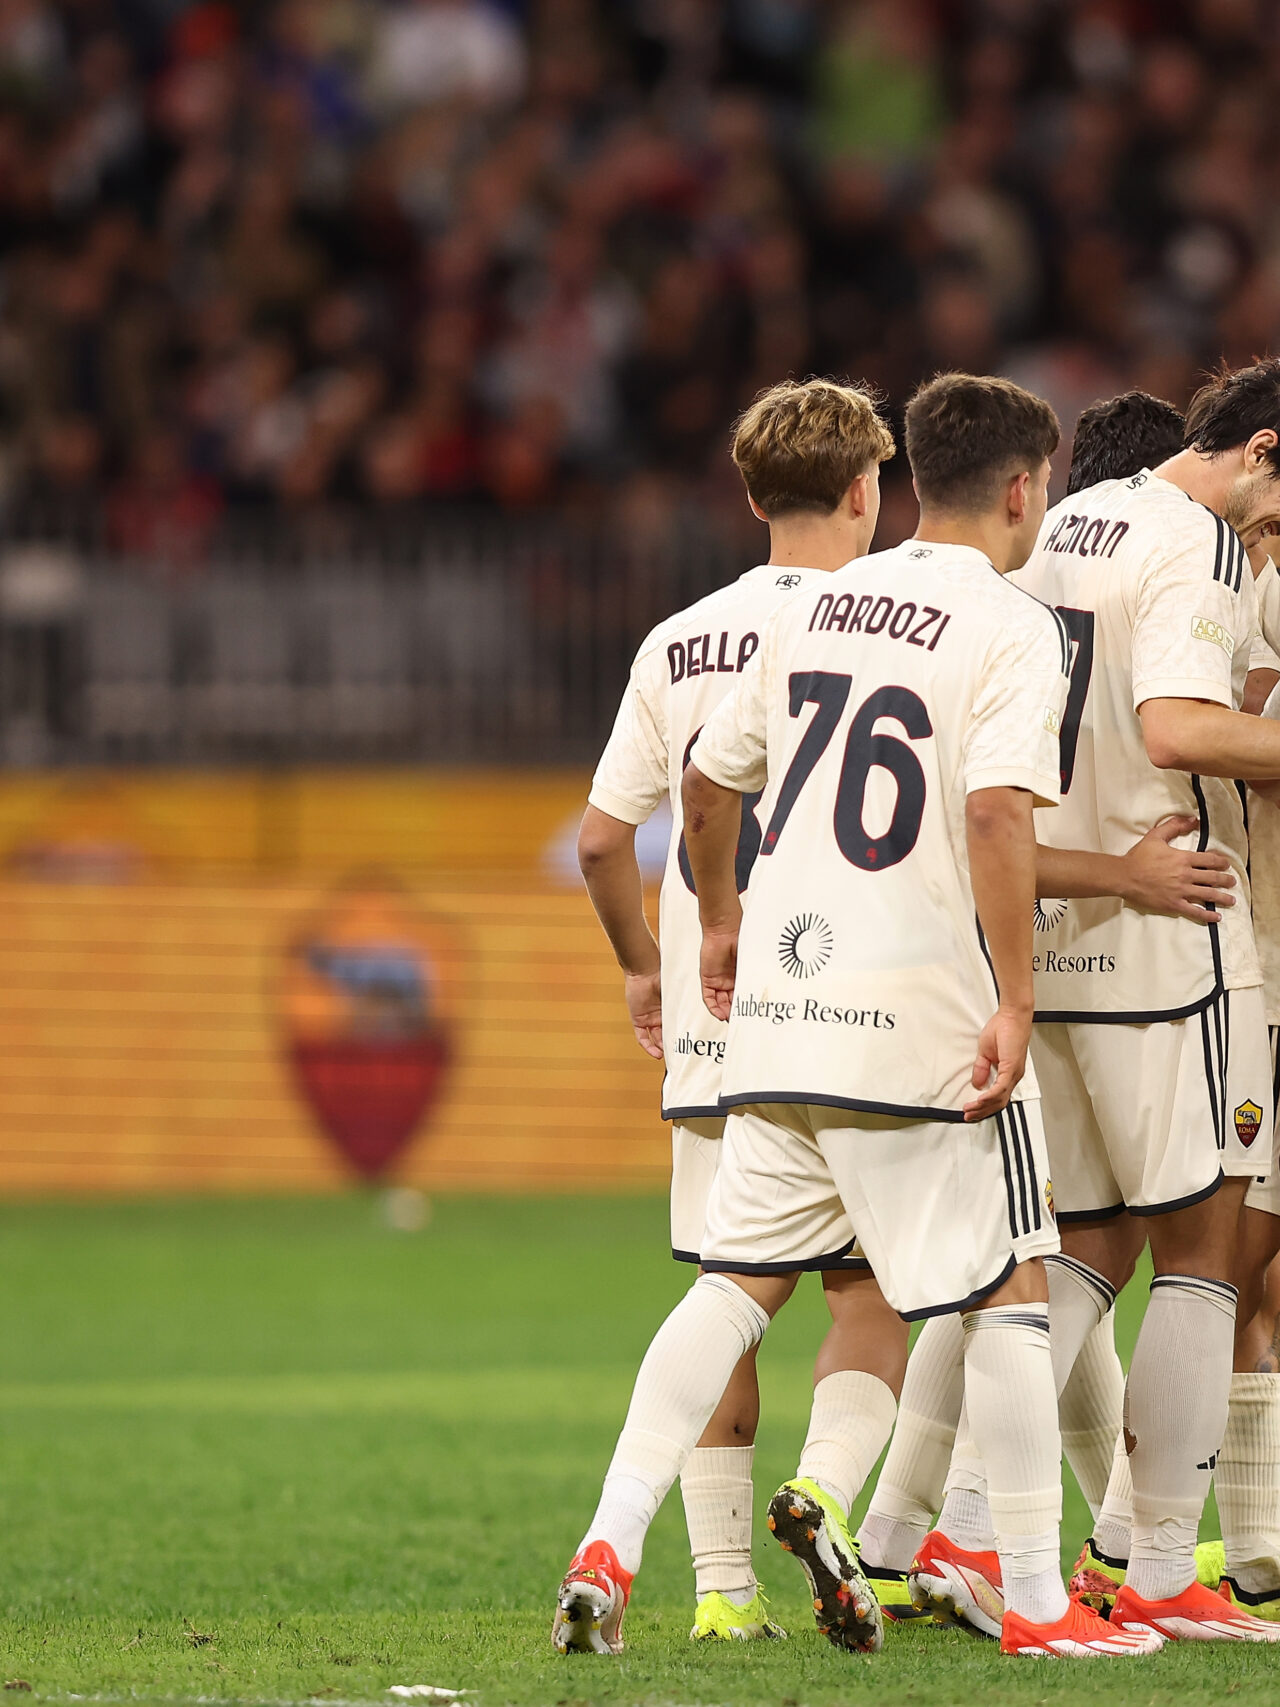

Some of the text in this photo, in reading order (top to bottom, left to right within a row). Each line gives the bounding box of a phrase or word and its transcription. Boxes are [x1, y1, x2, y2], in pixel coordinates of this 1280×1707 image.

[808, 593, 952, 652] NARDOZI
[760, 670, 934, 872] 76
[1045, 950, 1116, 973] Resorts
[802, 998, 896, 1030] Resorts
[674, 1031, 726, 1065] uberg
